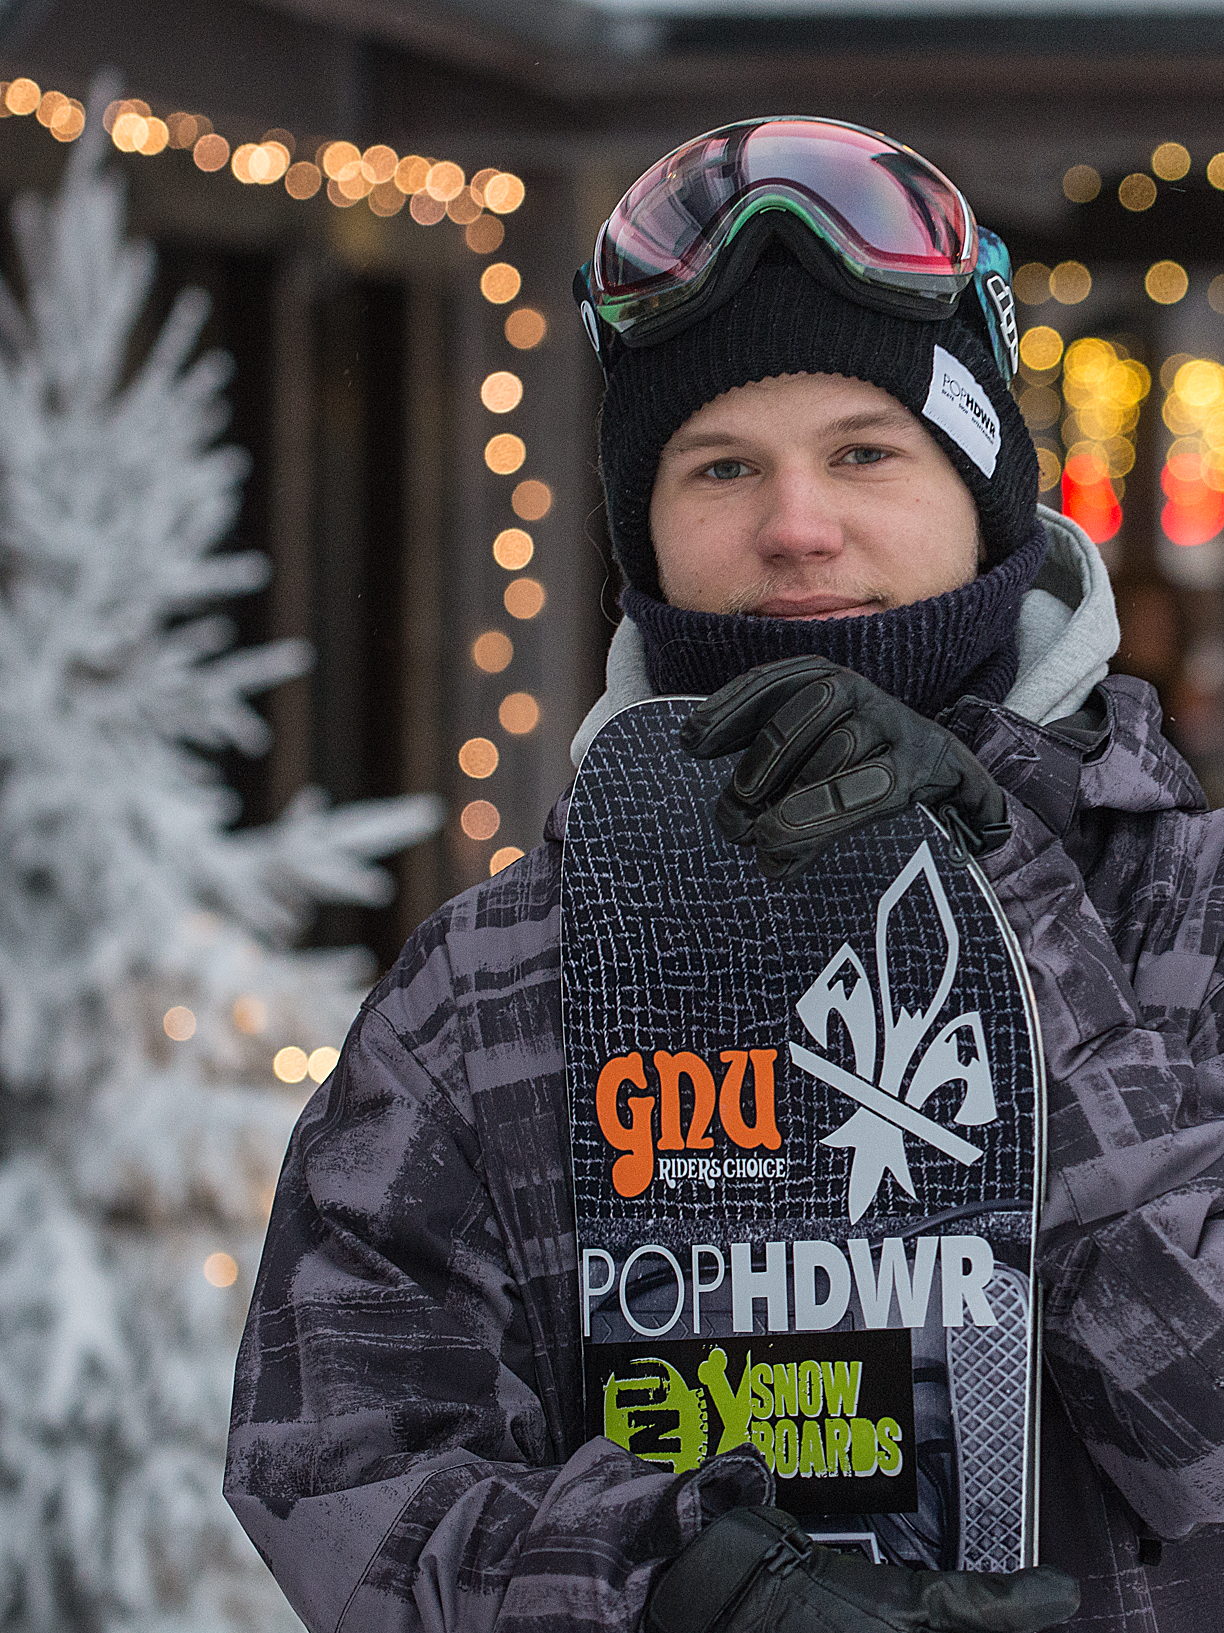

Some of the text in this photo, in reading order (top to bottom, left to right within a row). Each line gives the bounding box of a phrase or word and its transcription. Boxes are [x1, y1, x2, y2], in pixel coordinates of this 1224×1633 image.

[722, 1158, 786, 1179] CHOICE
[582, 1235, 998, 1338] POPHDWR
[751, 1360, 862, 1420] SNOW
[751, 1417, 904, 1479] BOARDS
